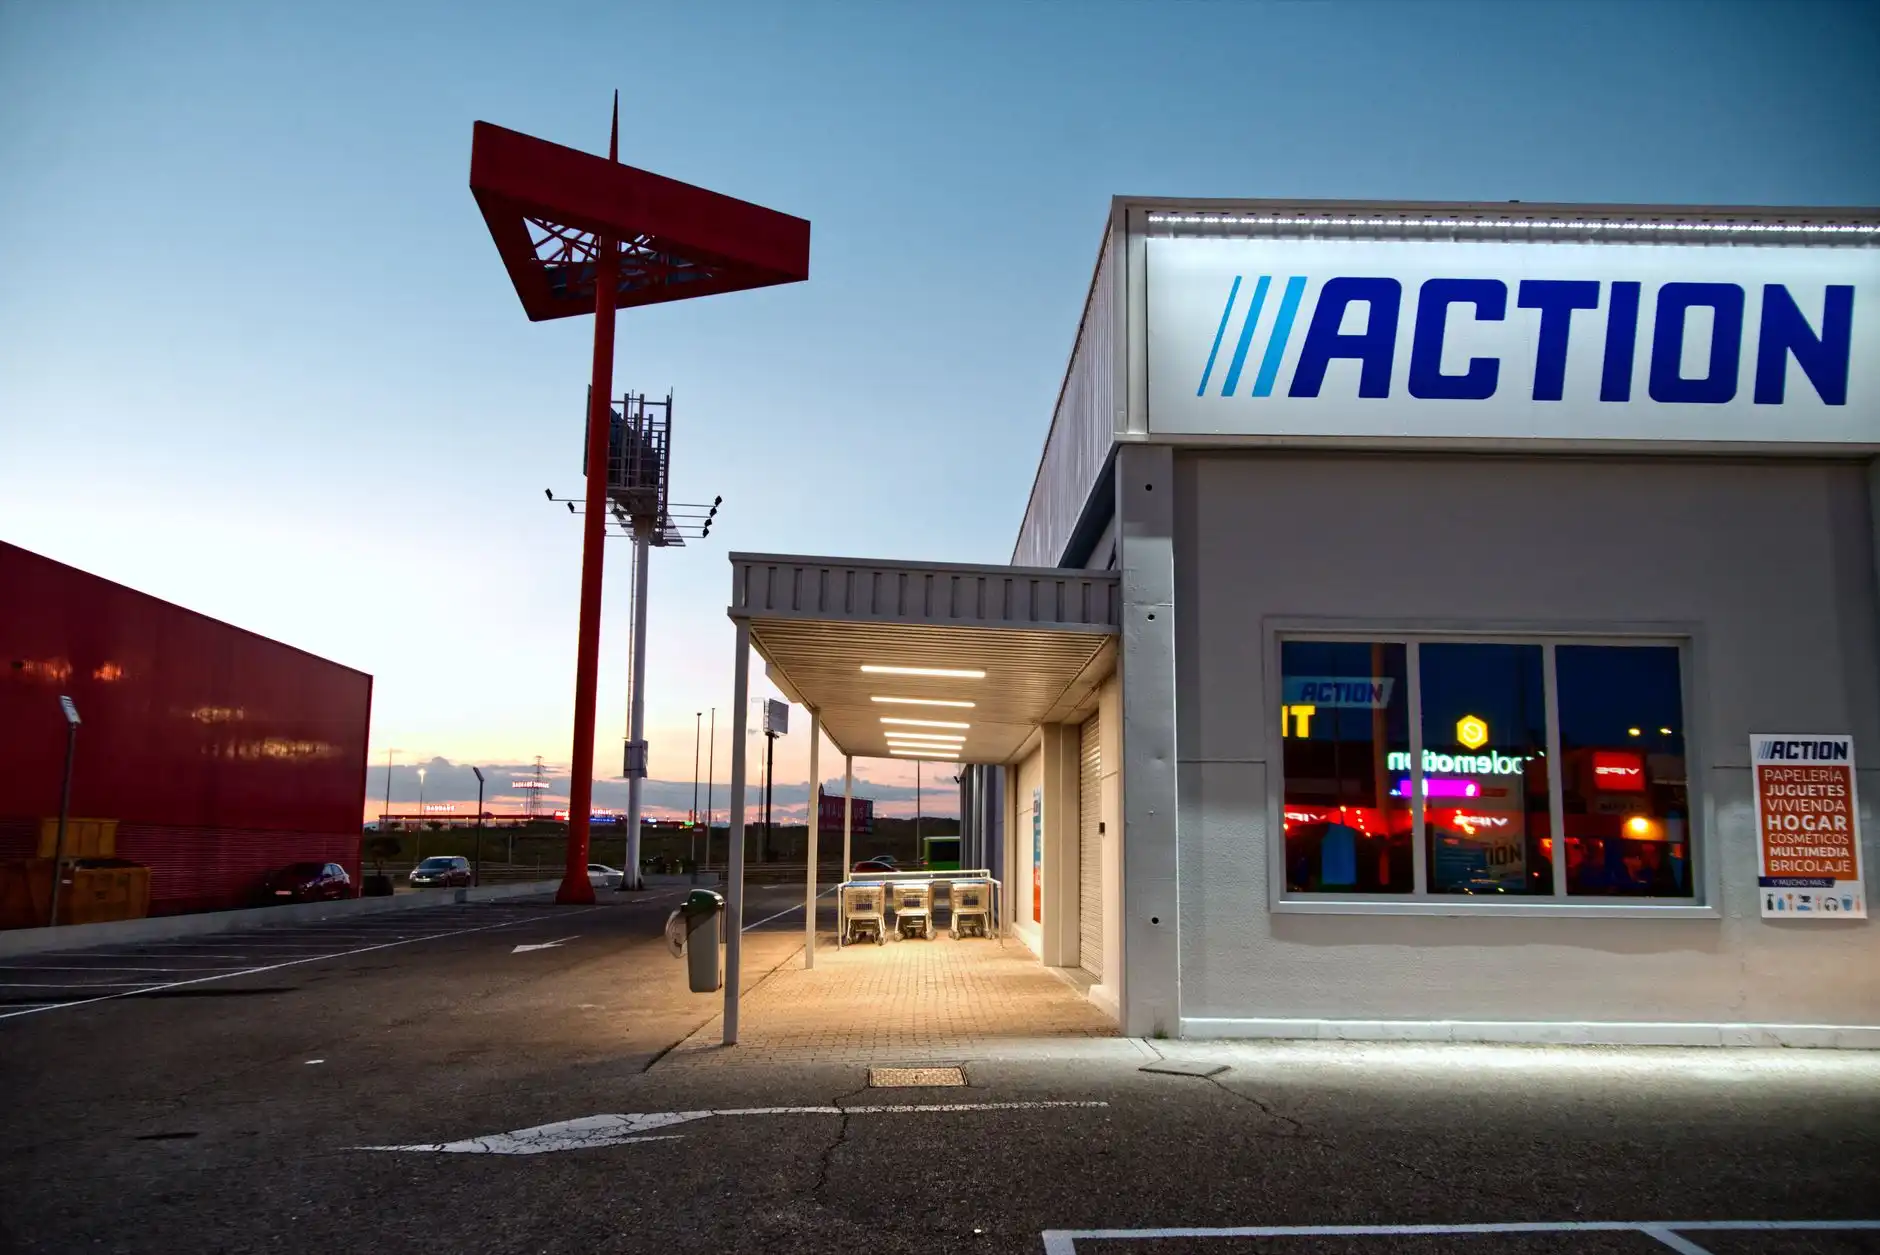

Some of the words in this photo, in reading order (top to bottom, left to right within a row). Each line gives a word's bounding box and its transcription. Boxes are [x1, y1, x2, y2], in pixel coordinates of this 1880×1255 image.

[1288, 277, 1855, 405] ACTION
[1301, 682, 1383, 703] ACTION
[1770, 741, 1848, 760] ACTION
[1764, 767, 1844, 782] PAPELERÍA
[1766, 784, 1845, 797] JUGUETES
[1766, 799, 1847, 813] VIVIENDA
[1767, 814, 1847, 831] HOGAR
[1769, 832, 1849, 844] COSMÉTICOS
[1770, 847, 1850, 857] MULTIMEDIA
[1771, 860, 1851, 872] BRICOLAJE
[1779, 879, 1808, 887] MUCHO
